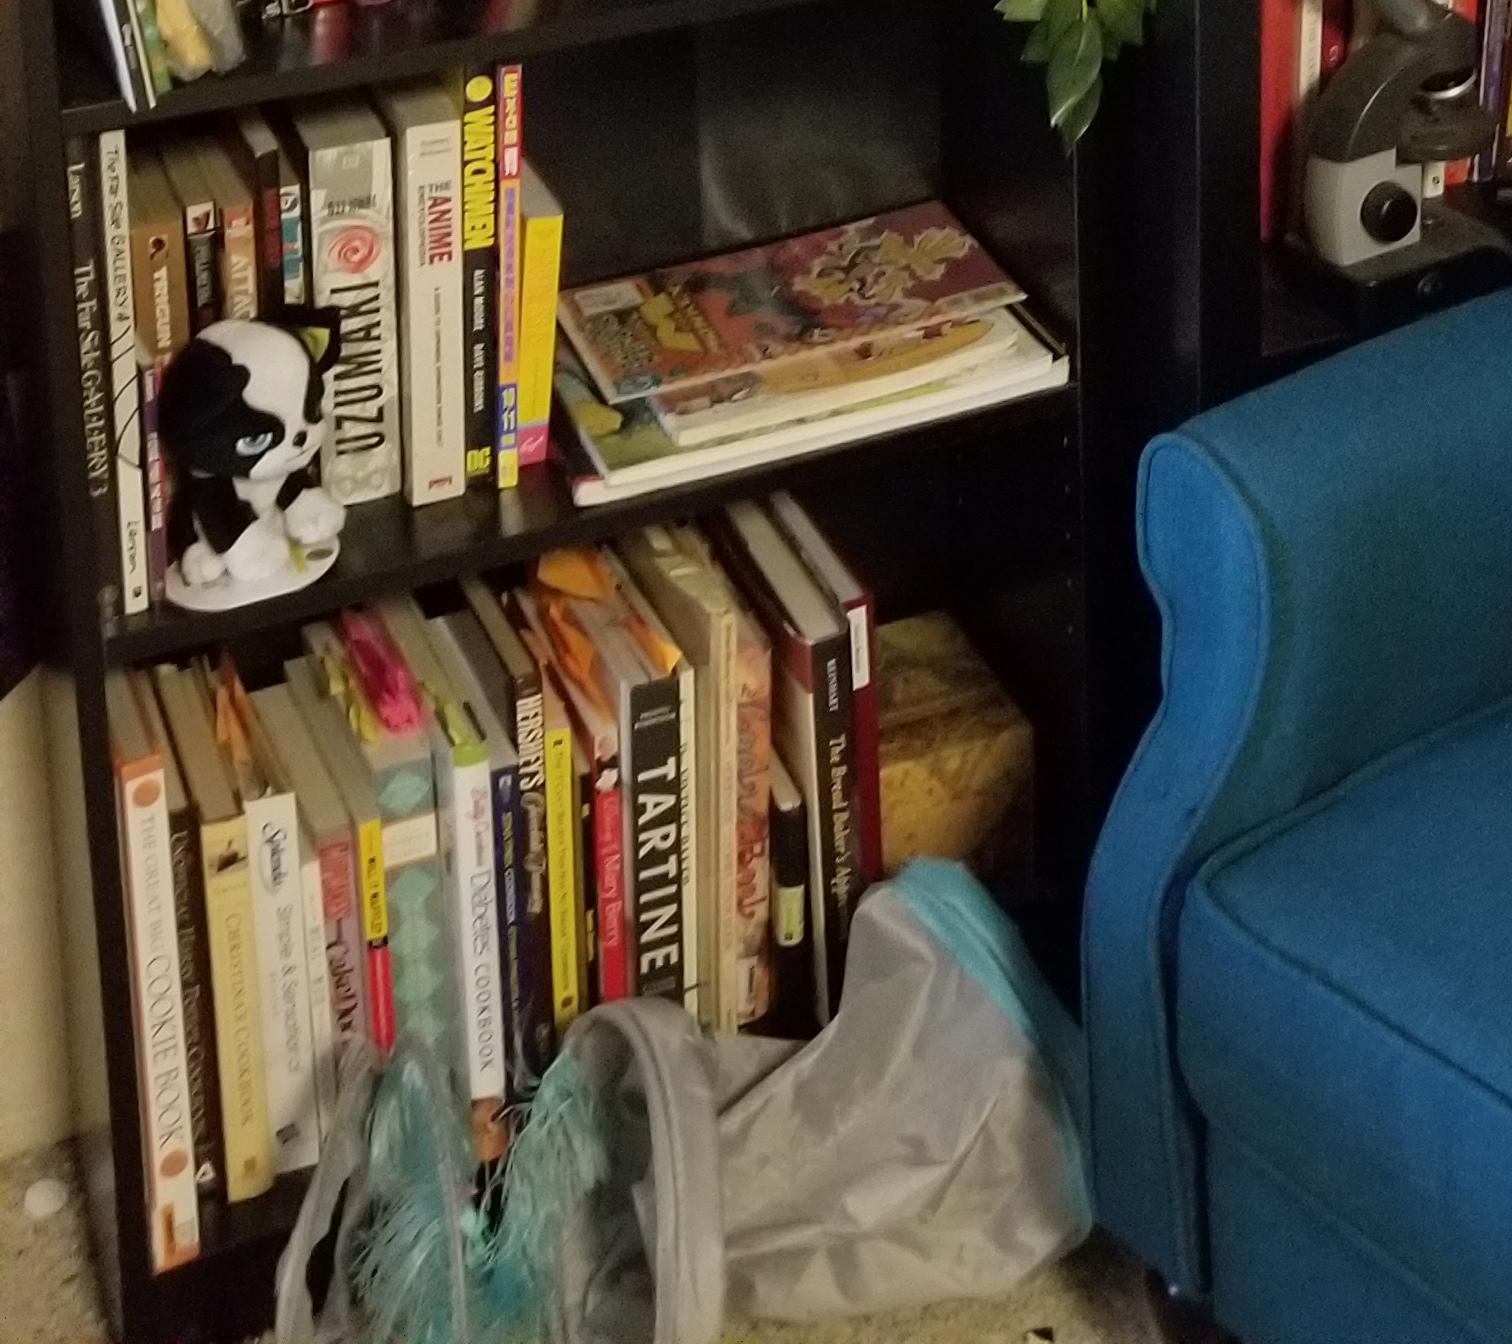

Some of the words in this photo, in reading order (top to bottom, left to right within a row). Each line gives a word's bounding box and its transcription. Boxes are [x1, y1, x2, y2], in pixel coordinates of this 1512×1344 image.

[68, 163, 85, 218] Larson
[104, 146, 119, 172] The
[463, 106, 495, 251] WATCHMEN
[110, 233, 129, 309] GALLERY
[427, 193, 453, 266] ANIME
[73, 259, 97, 298] The
[76, 299, 98, 326] Far
[152, 265, 172, 348] TRIGUN
[79, 328, 101, 367] Side
[330, 278, 385, 457] UZUMAKI
[81, 368, 107, 477] GALLERY
[515, 693, 546, 791] HERSHEY'S
[828, 733, 846, 762] The
[831, 764, 850, 810] Bread
[636, 755, 680, 977] TARTINE
[469, 870, 494, 957] Diabetes
[145, 954, 181, 1064] COOKIE
[475, 963, 497, 1073] COOKBOOK
[153, 1067, 187, 1150] BOOK
